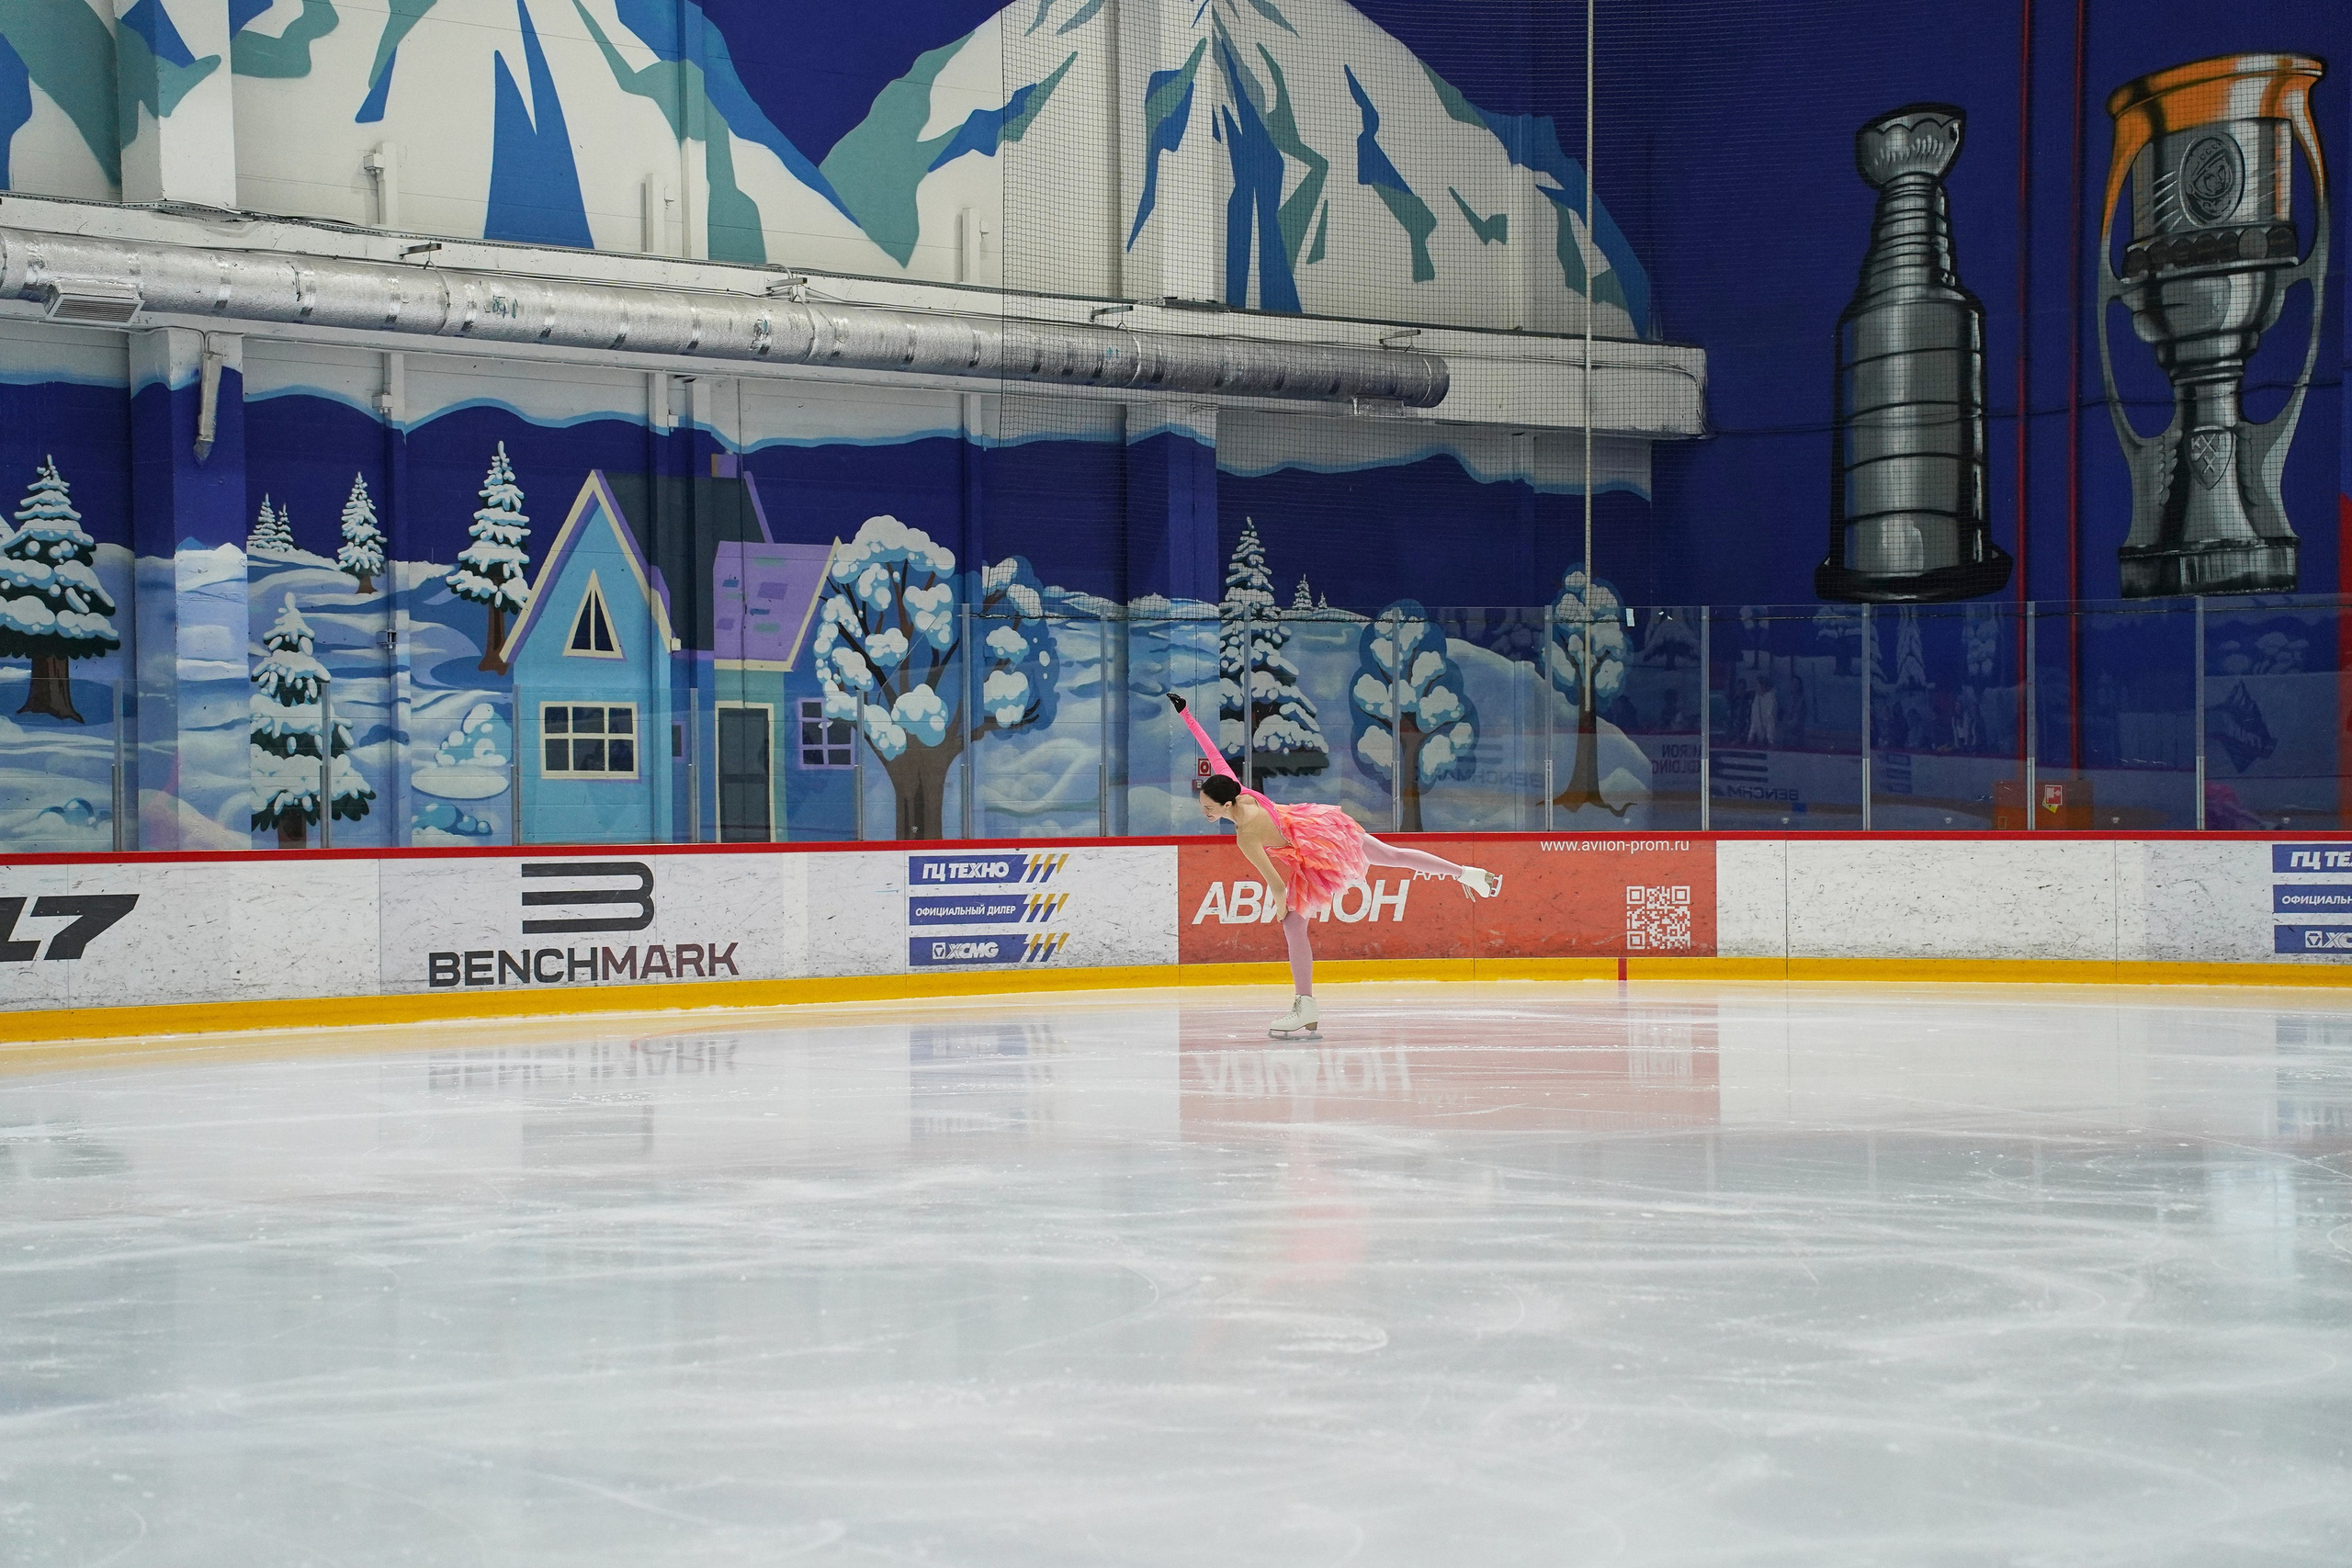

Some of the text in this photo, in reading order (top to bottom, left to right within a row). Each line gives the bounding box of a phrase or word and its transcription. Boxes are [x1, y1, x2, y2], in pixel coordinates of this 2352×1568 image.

[2290, 851, 2321, 870] ГЦ
[922, 861, 1010, 882] ГЦ ТЕХНО
[915, 904, 1016, 918] ОФИЦИАЛЬНЫЙ ДИЛЕР
[946, 942, 1000, 960] XCMG
[428, 942, 740, 988] BENCHMARK
